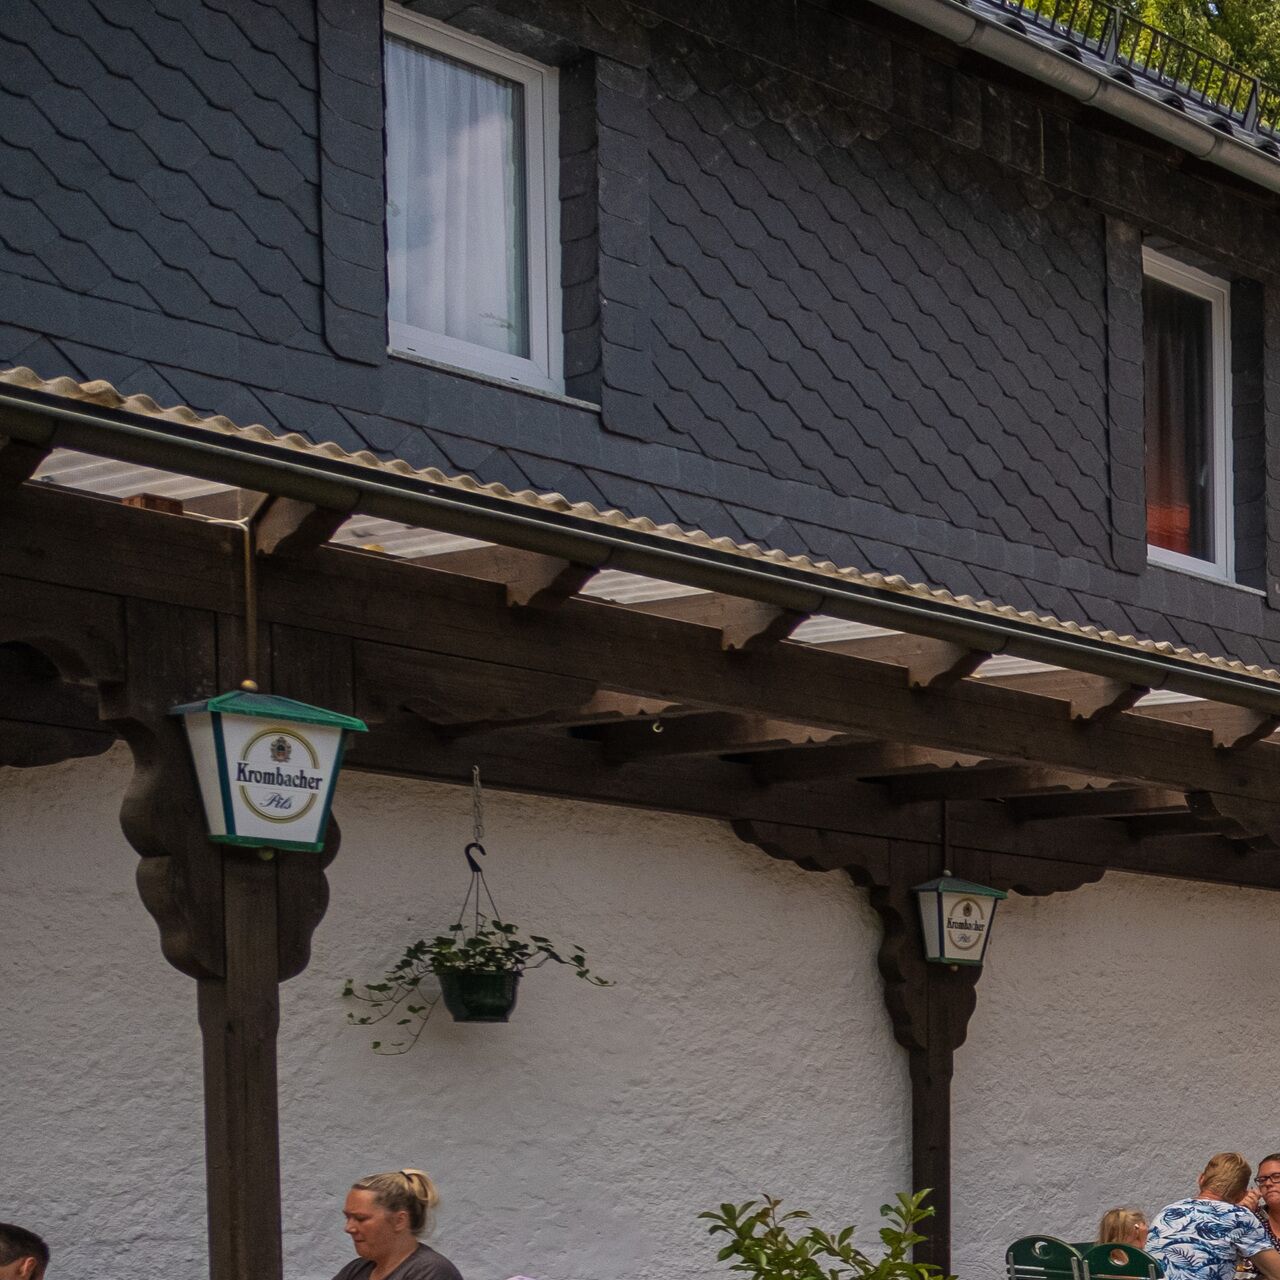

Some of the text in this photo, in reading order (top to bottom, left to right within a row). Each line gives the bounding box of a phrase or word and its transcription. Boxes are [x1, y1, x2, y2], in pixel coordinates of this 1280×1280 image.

[237, 762, 323, 790] Krombacher
[259, 791, 296, 810] Pils
[947, 917, 985, 932] Krombacher
